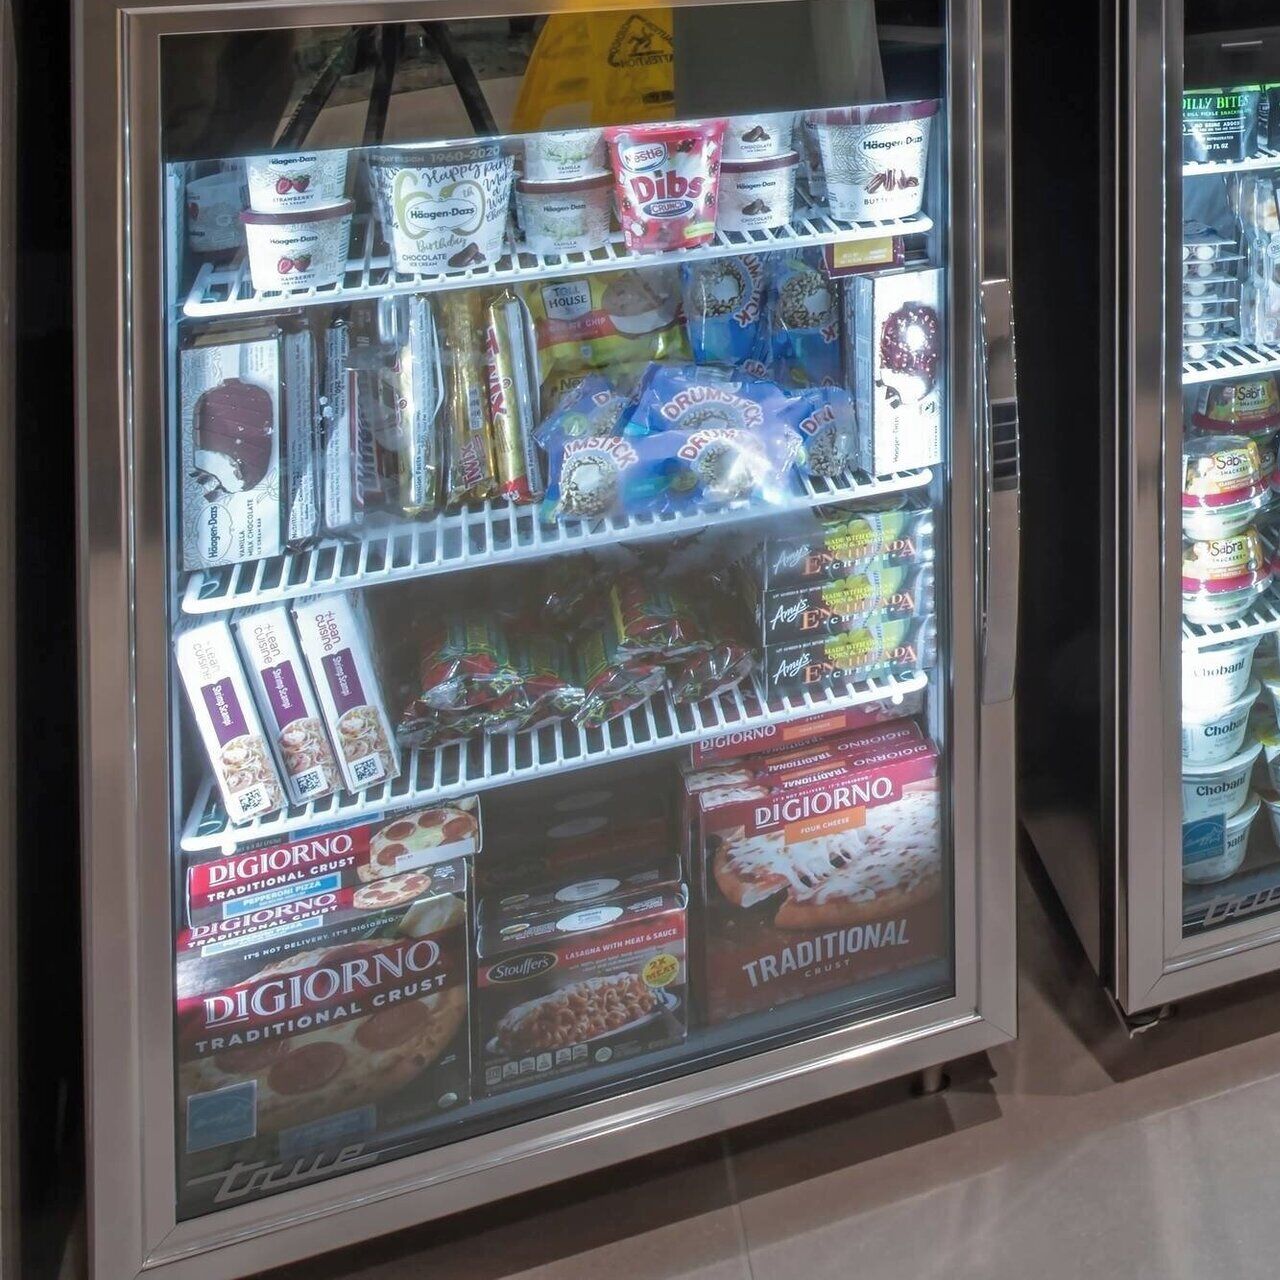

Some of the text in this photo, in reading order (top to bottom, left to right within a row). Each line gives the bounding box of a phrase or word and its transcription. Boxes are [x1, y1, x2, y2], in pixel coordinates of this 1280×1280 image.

[629, 170, 705, 204] Dibs
[410, 206, 475, 221] Häagen-Dazs
[651, 201, 686, 214] CRUNCH
[402, 254, 447, 262] CHOCOLATE
[548, 294, 588, 307] HOUSE
[1238, 385, 1266, 403] Sabra
[208, 505, 219, 559] Häagen-Dazs
[773, 543, 812, 575] Amy's
[1210, 539, 1244, 558] Sabra
[770, 598, 809, 630] Amy's
[773, 652, 812, 685] Amy's
[700, 724, 777, 752] DIGIORNO
[1196, 773, 1247, 797] Chobani
[755, 776, 895, 830] DIGIORNO
[822, 817, 850, 831] CHEESE
[207, 833, 354, 888] DIGIORNO
[207, 855, 356, 903] TRADITIONAL CRUST
[186, 904, 338, 949] TRADITIONAL CRUST
[190, 893, 337, 940] DIGIORNO
[564, 928, 678, 961] LASAGNA WITH MEAT SAUCE
[742, 919, 909, 989] TRADITIONAL
[204, 938, 443, 1029] DIGIORNO
[494, 957, 551, 980] Stouffer's
[804, 959, 851, 979] CRUST
[196, 973, 447, 1054] TRADITIONAL CRUST
